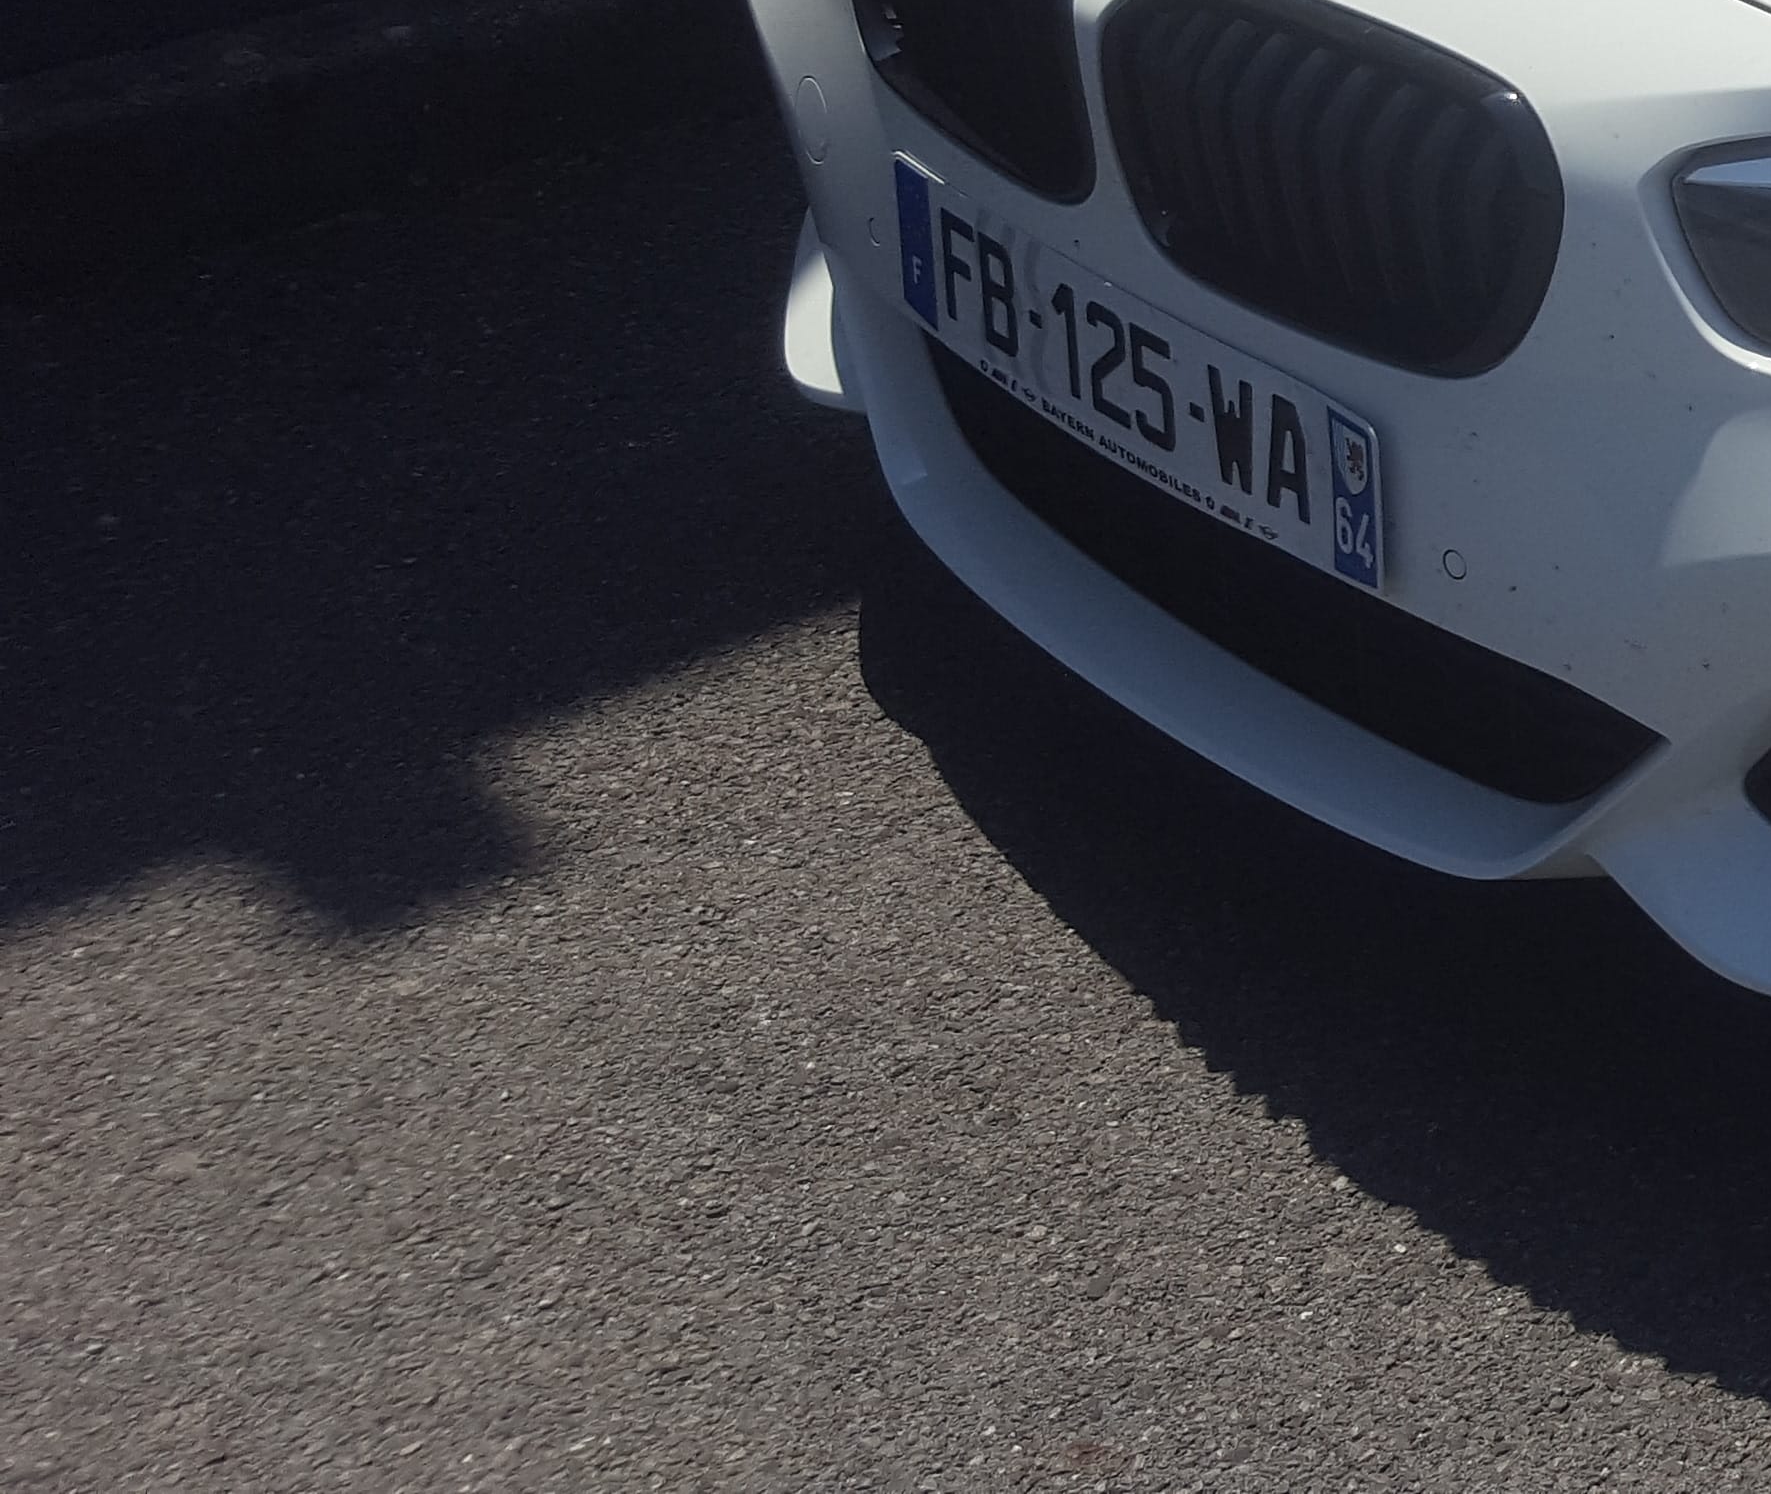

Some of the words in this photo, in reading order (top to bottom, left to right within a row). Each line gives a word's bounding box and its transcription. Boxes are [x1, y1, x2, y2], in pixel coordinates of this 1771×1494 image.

[911, 256, 923, 285] F
[940, 207, 1311, 525] FB-125-WA
[1040, 397, 1095, 441] BAYERN
[1098, 435, 1201, 503] AUTOMOBILES
[1335, 495, 1374, 570] 64
